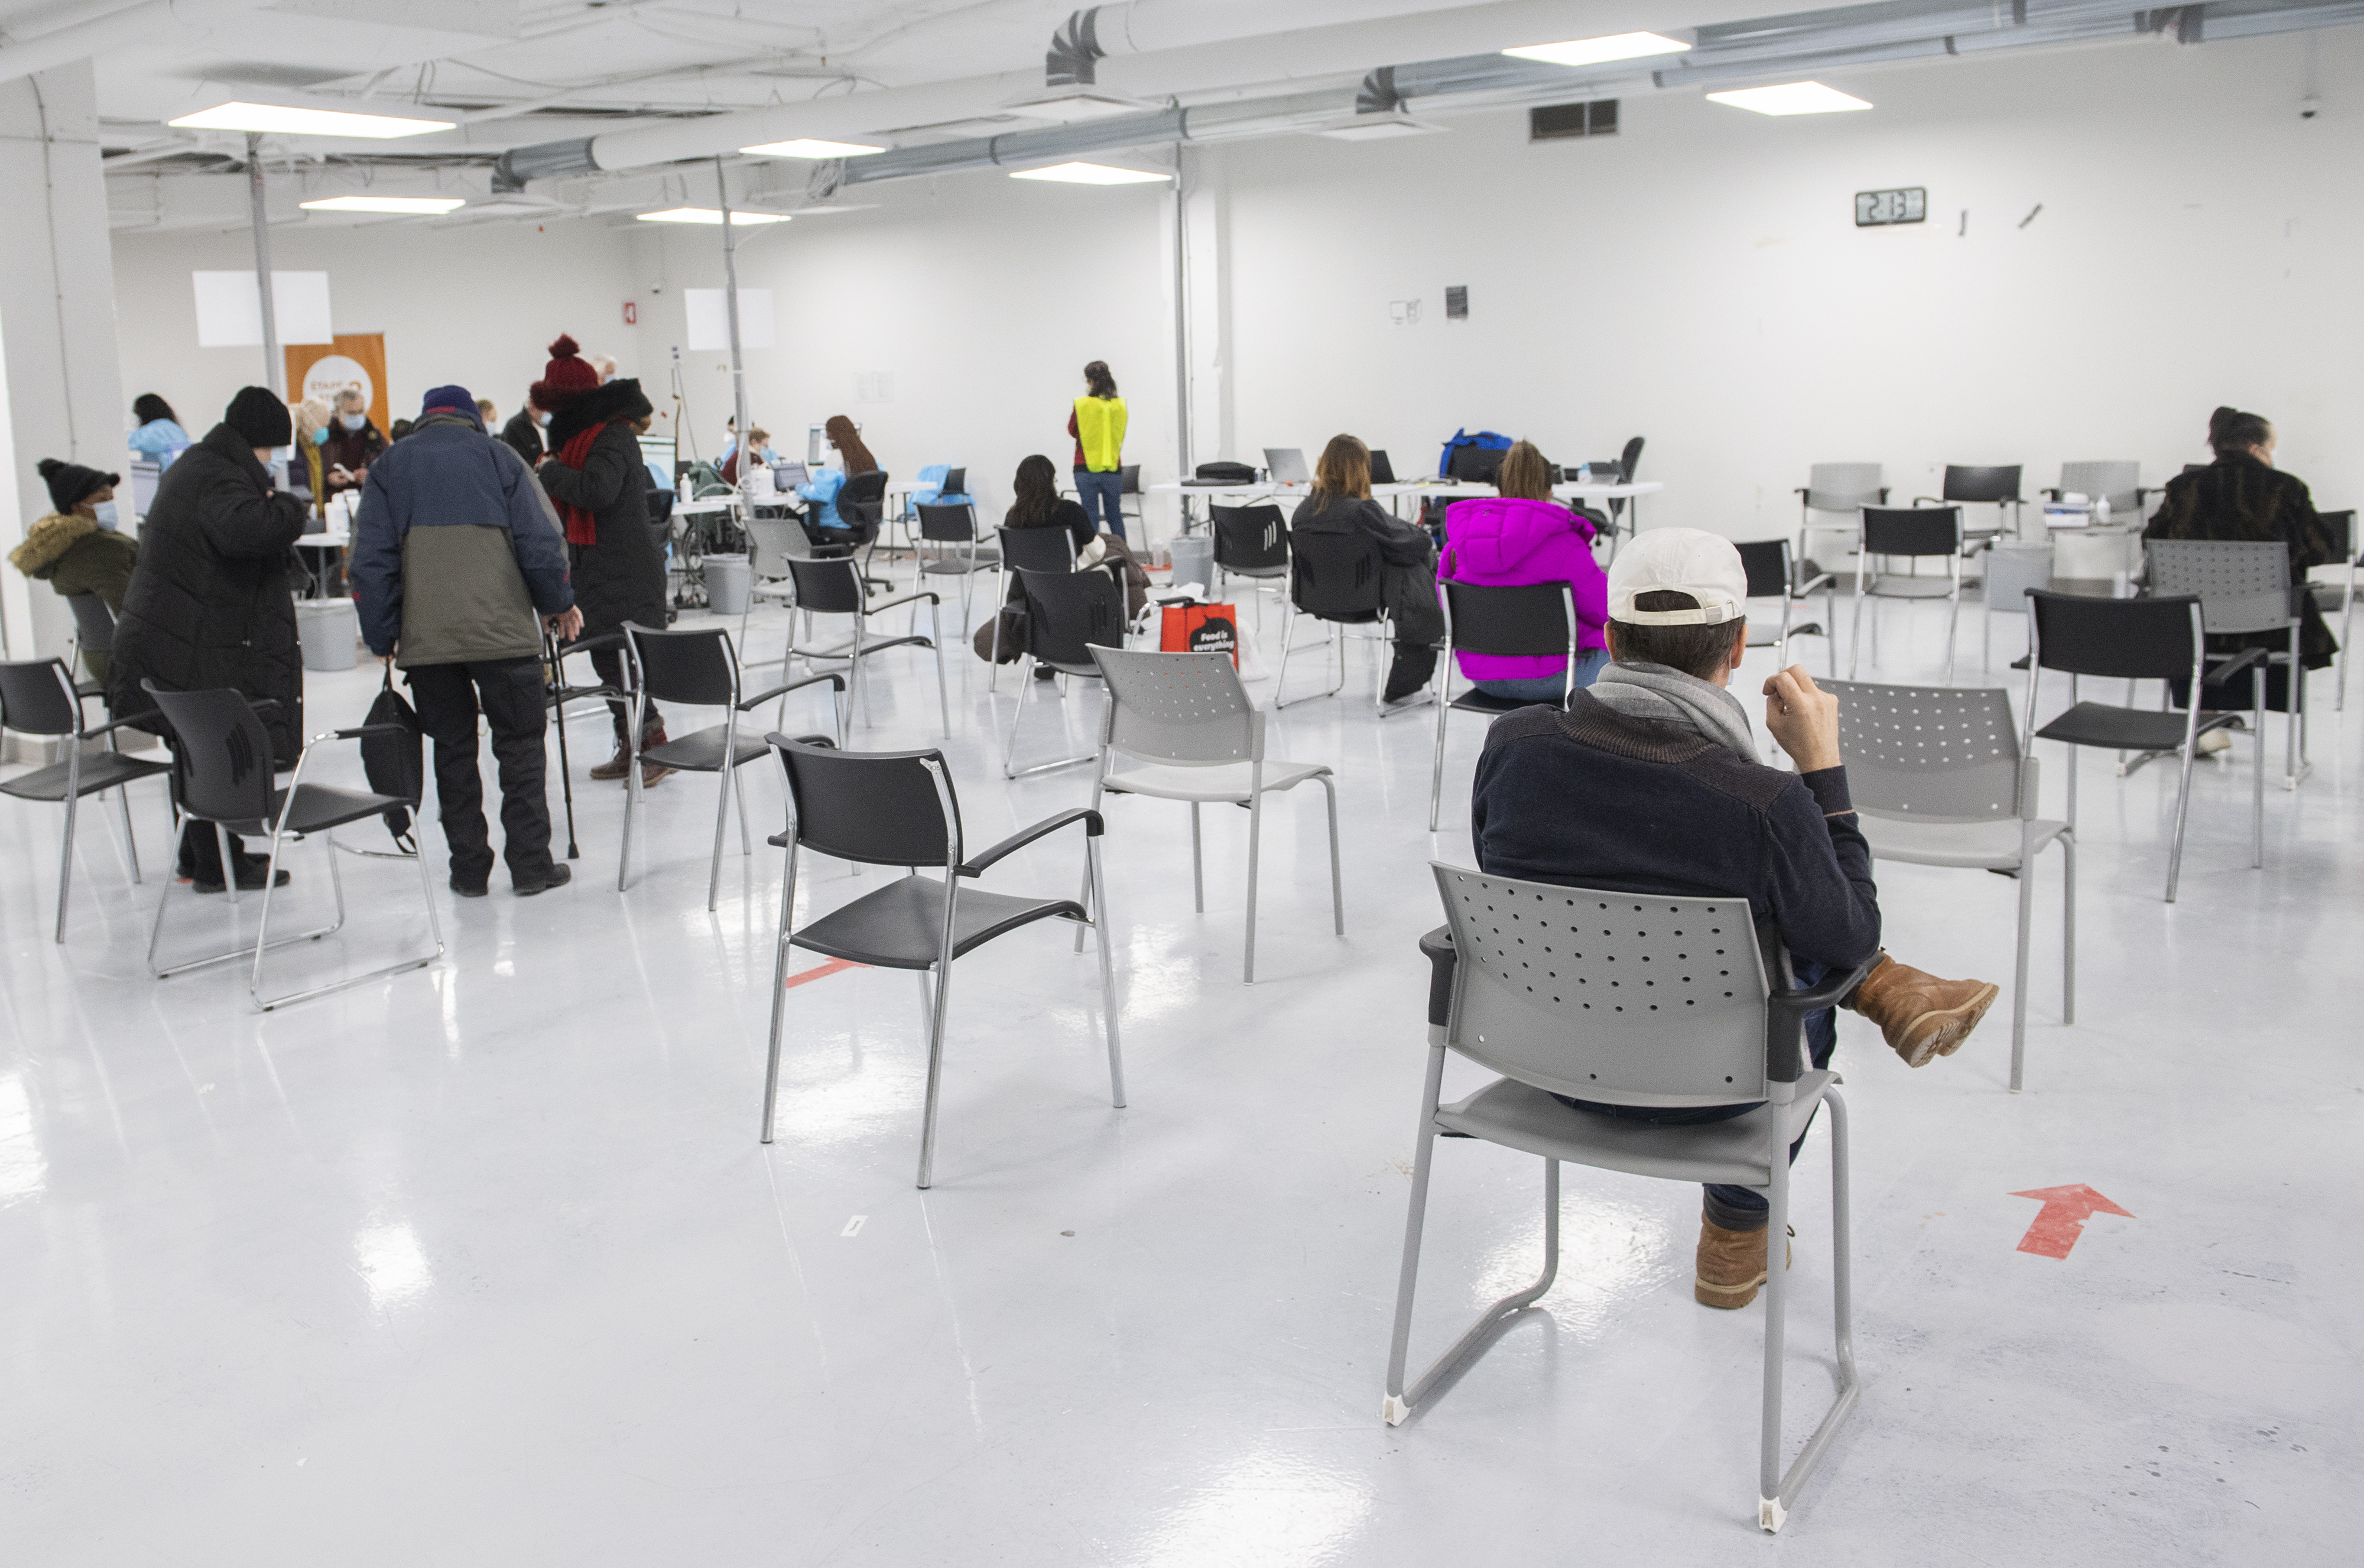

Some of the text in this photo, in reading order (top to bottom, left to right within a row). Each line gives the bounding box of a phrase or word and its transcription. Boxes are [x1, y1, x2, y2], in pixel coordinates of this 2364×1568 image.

[1868, 190, 1907, 220] 2:13
[1200, 630, 1228, 642] Food is
[1193, 639, 1235, 651] everything
